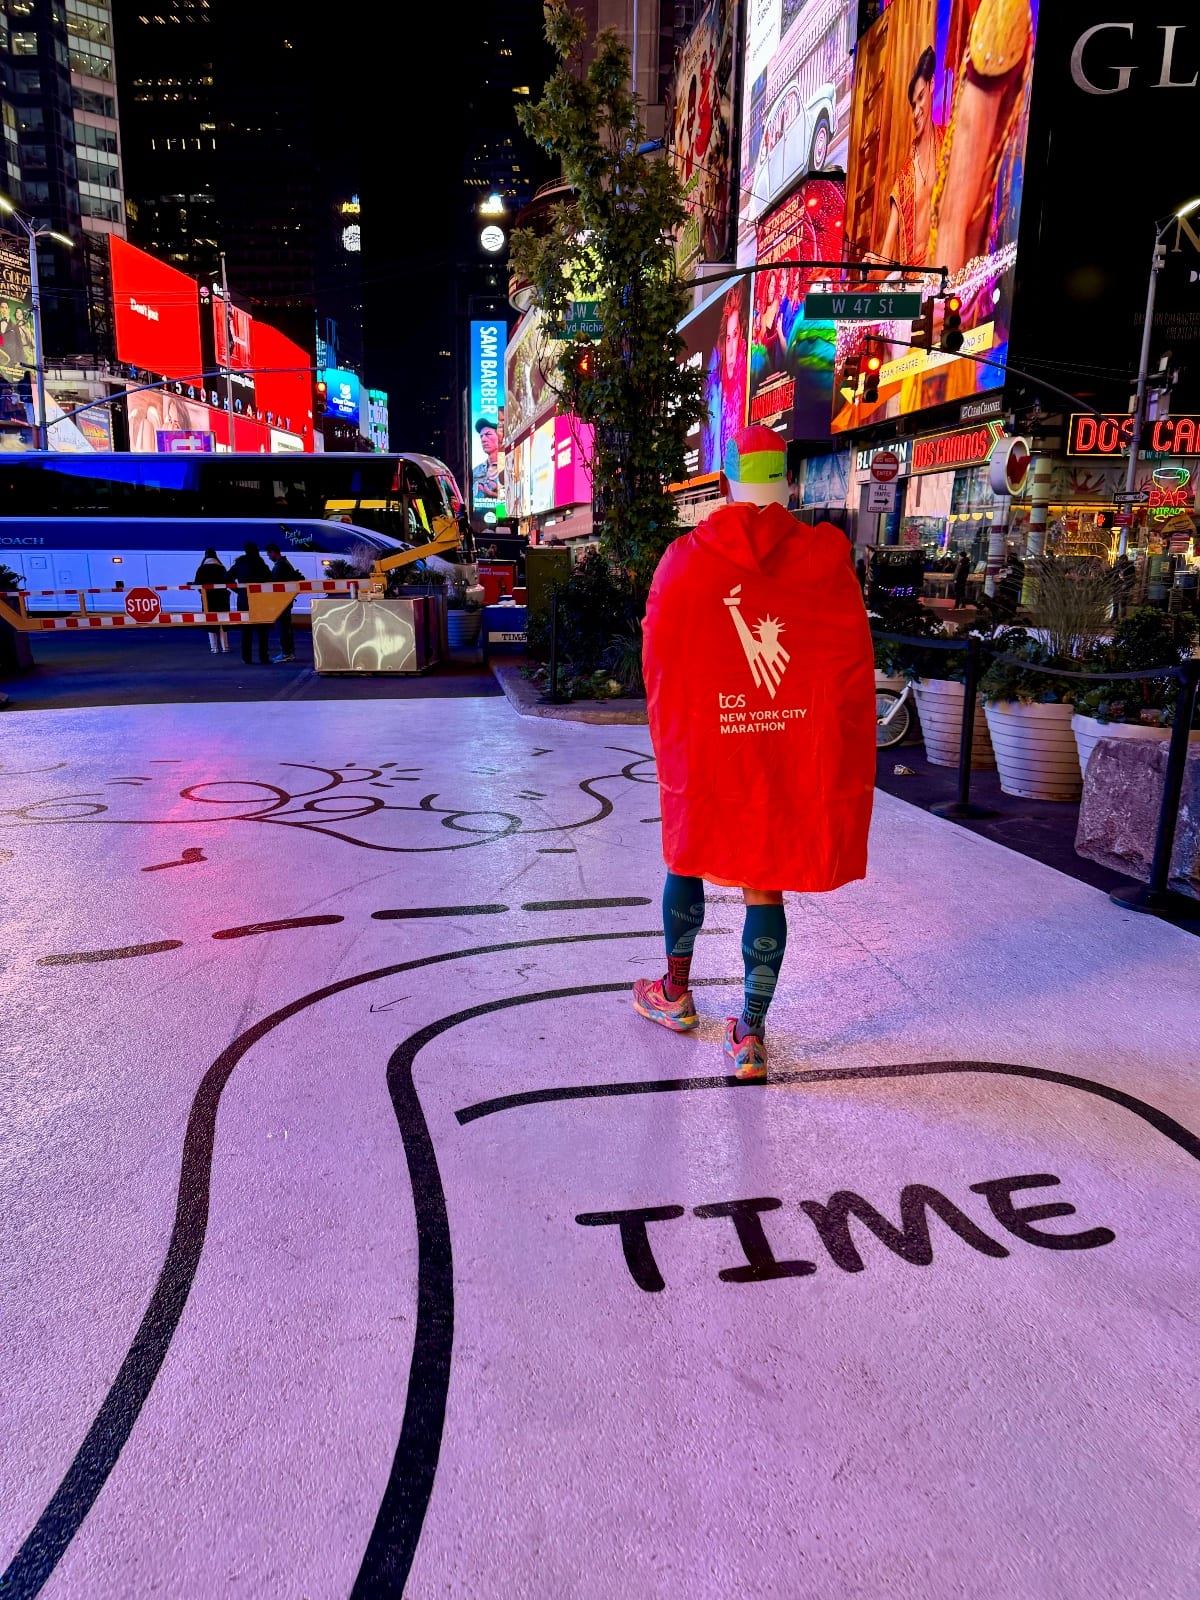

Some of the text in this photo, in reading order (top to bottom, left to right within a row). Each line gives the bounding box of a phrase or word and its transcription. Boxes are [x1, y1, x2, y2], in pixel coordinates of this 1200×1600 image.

[577, 303, 587, 319] W
[832, 297, 894, 314] W 47 St
[581, 322, 605, 333] Richa
[480, 326, 498, 414] SAM BARBER
[914, 429, 988, 468] DOS CAMINOS
[1148, 490, 1188, 507] BAR
[127, 598, 158, 612] STOP
[719, 692, 746, 709] tcs
[720, 708, 807, 723] NEW YORK CITY
[720, 721, 785, 735] MARATHON
[574, 1173, 1117, 1293] TIME
